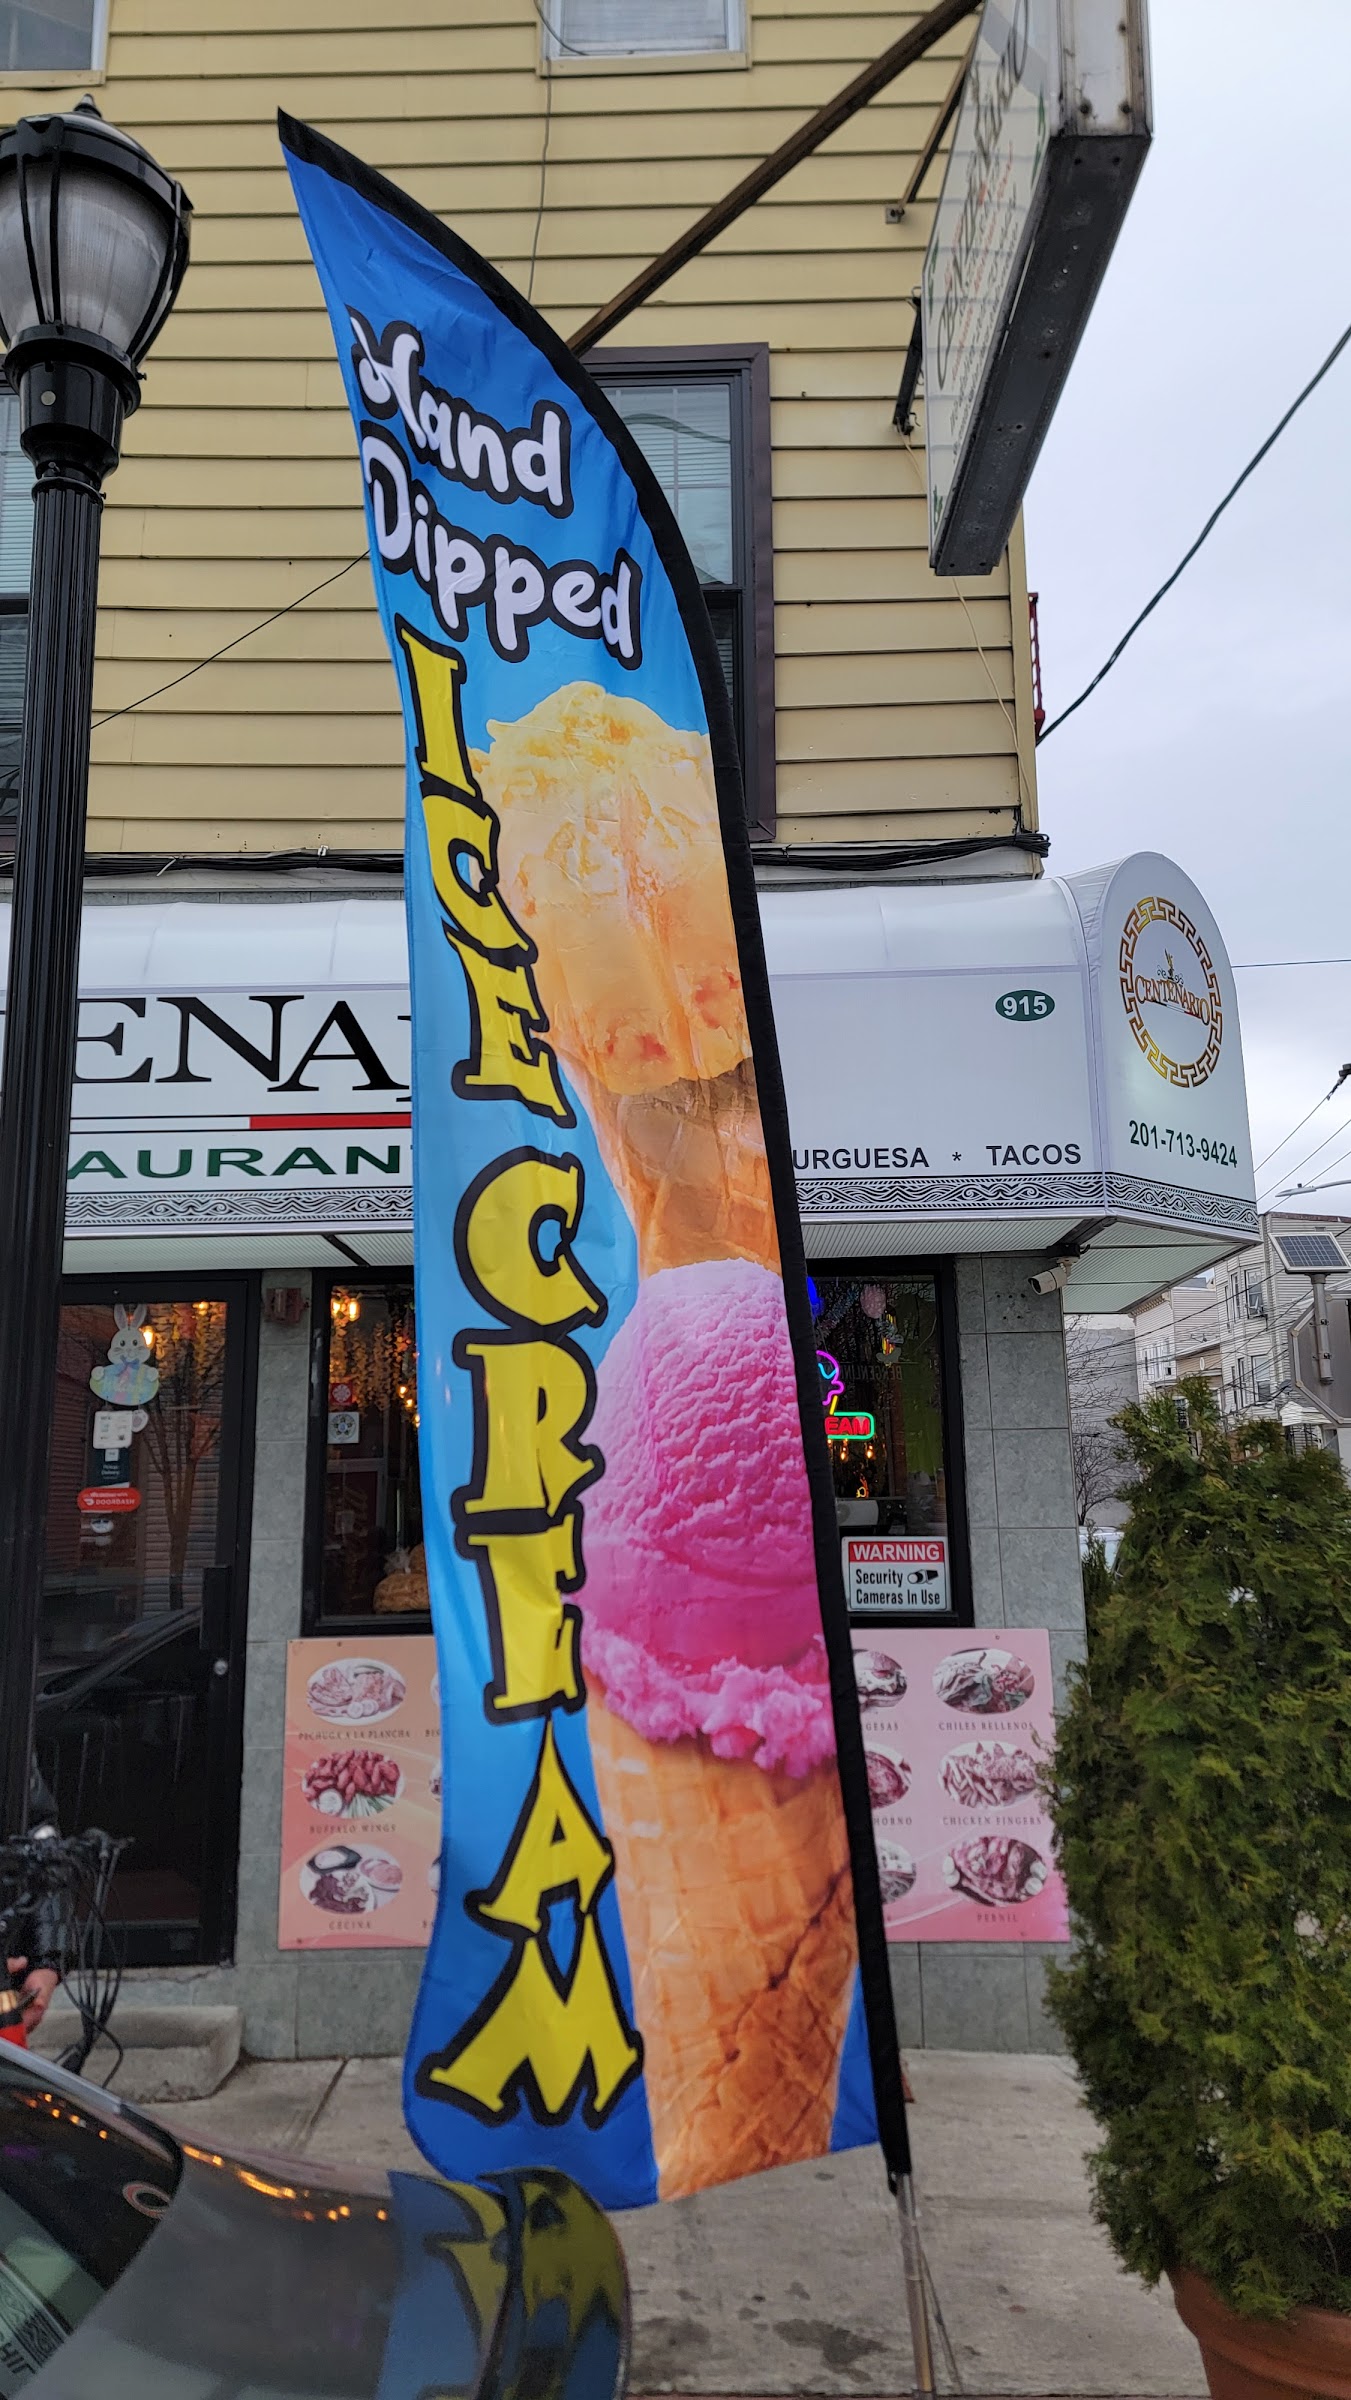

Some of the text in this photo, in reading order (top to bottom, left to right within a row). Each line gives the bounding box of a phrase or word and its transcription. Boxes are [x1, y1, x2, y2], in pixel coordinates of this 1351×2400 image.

[346, 305, 573, 518] Hand
[360, 422, 642, 669] Dipped
[396, 614, 576, 1128] ICE
[1003, 995, 1048, 1017] 915
[1135, 974, 1211, 1026] CENTENARIO
[72, 995, 412, 1103] ENA
[1129, 1120, 1238, 1168] 201-713-9424
[67, 1145, 413, 1179] AURAN
[793, 1144, 1082, 1169] URGUESA TACOS
[825, 1416, 871, 1436] EAM
[853, 1544, 940, 1561] WARNING
[856, 1568, 904, 1588] Security
[856, 1588, 940, 1605] Cameras In Use
[416, 1147, 642, 2127] CREAM
[368, 1729, 411, 1739] PLANCHA
[938, 1721, 1034, 1731] CHILES RELLENOS
[309, 1823, 397, 1835] BUFFALO WINGS
[942, 1815, 1042, 1826] CHICKEN FINGERS
